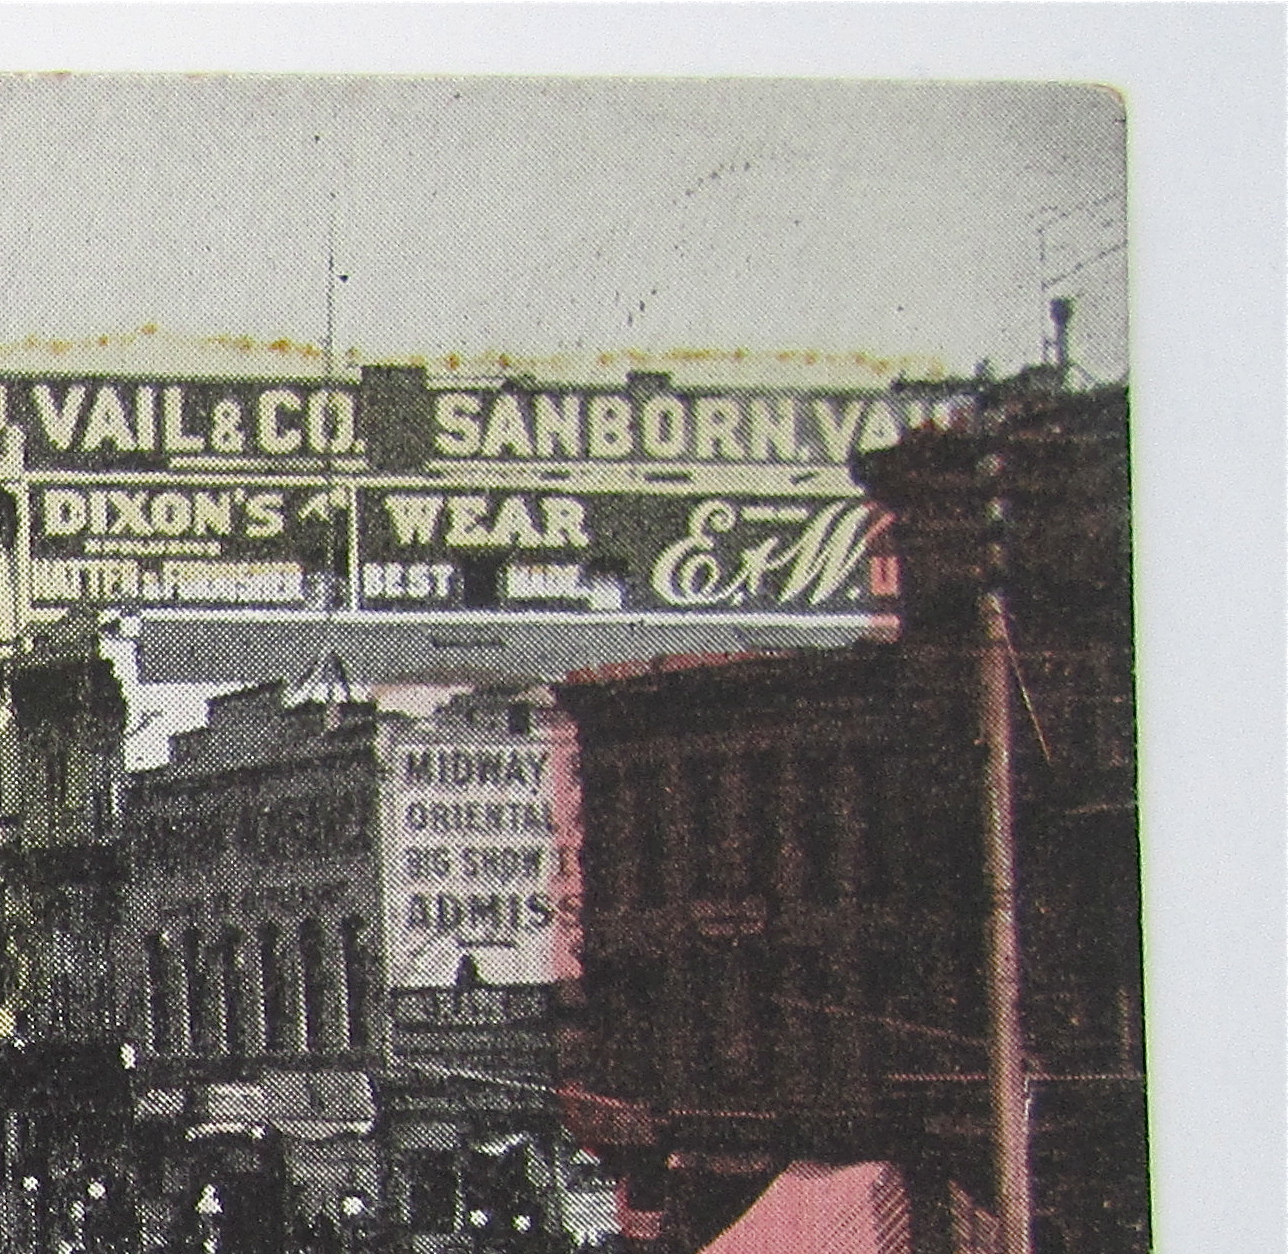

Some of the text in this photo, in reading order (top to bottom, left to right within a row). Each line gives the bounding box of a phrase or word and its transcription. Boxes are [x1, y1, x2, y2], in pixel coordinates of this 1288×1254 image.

[31, 384, 205, 453] VAIL
[42, 485, 286, 540] DIXON'S
[384, 494, 590, 548] WEAR
[362, 562, 454, 598] BEST
[406, 750, 551, 787] MIDWAY
